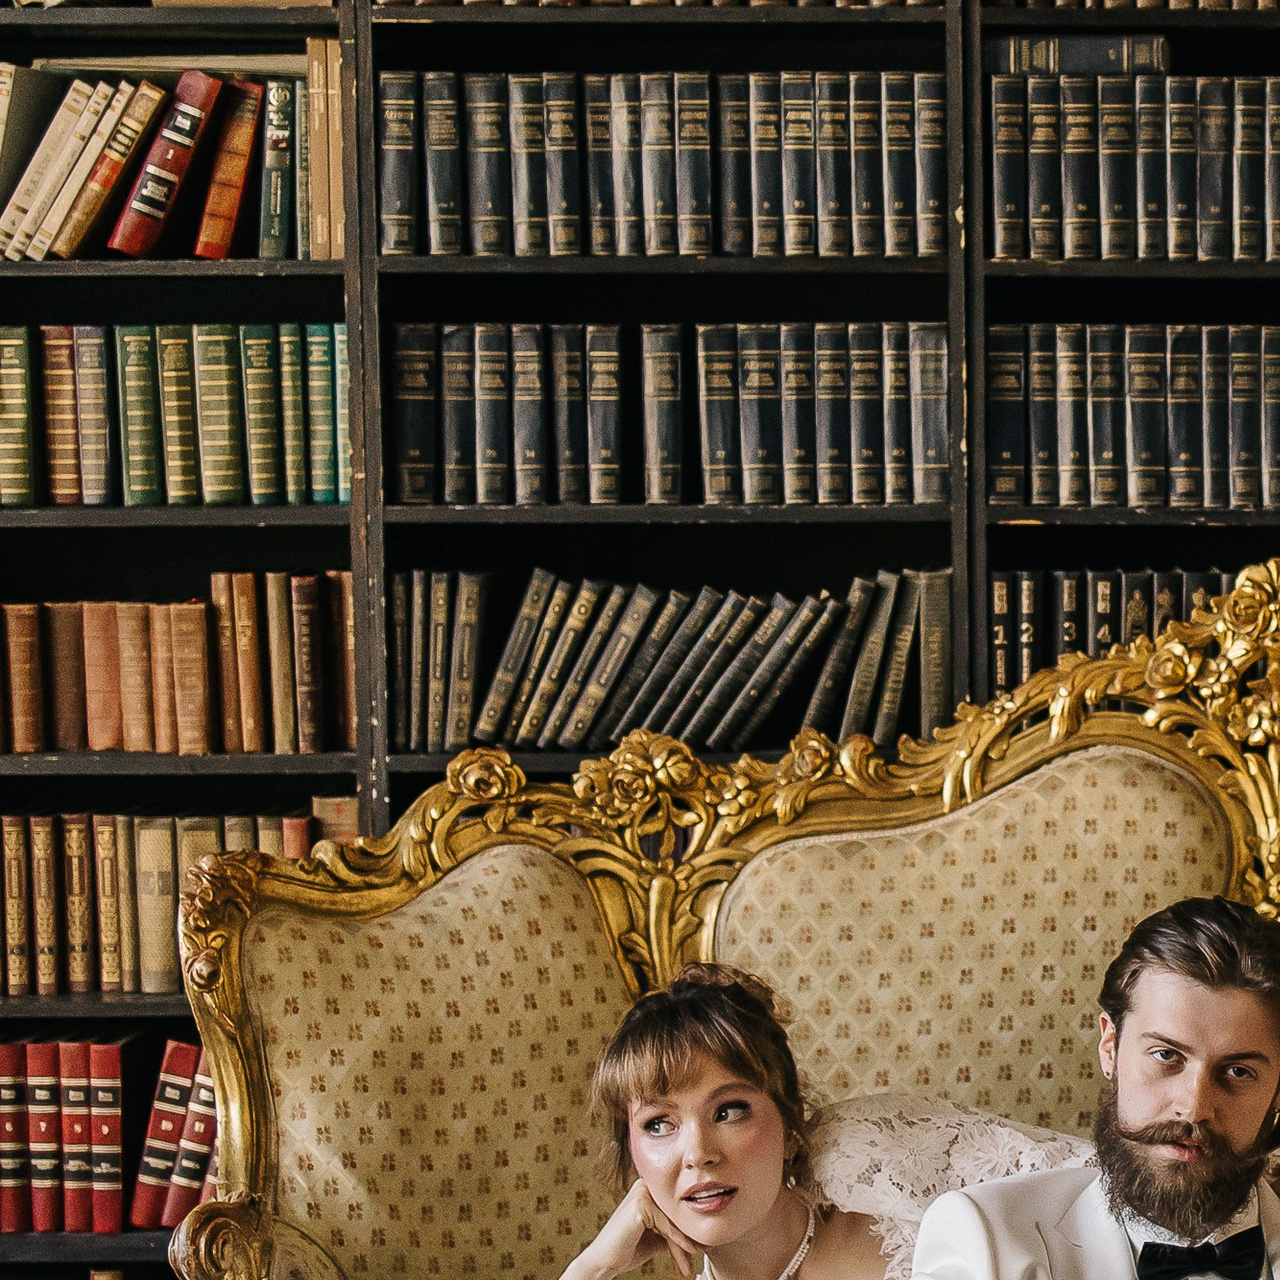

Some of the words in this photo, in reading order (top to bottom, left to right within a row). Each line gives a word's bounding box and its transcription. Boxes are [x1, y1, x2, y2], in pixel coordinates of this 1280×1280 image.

[994, 625, 1008, 645] 1
[1020, 622, 1034, 643] 2
[1063, 621, 1077, 641] 3
[1097, 624, 1111, 642] 4
